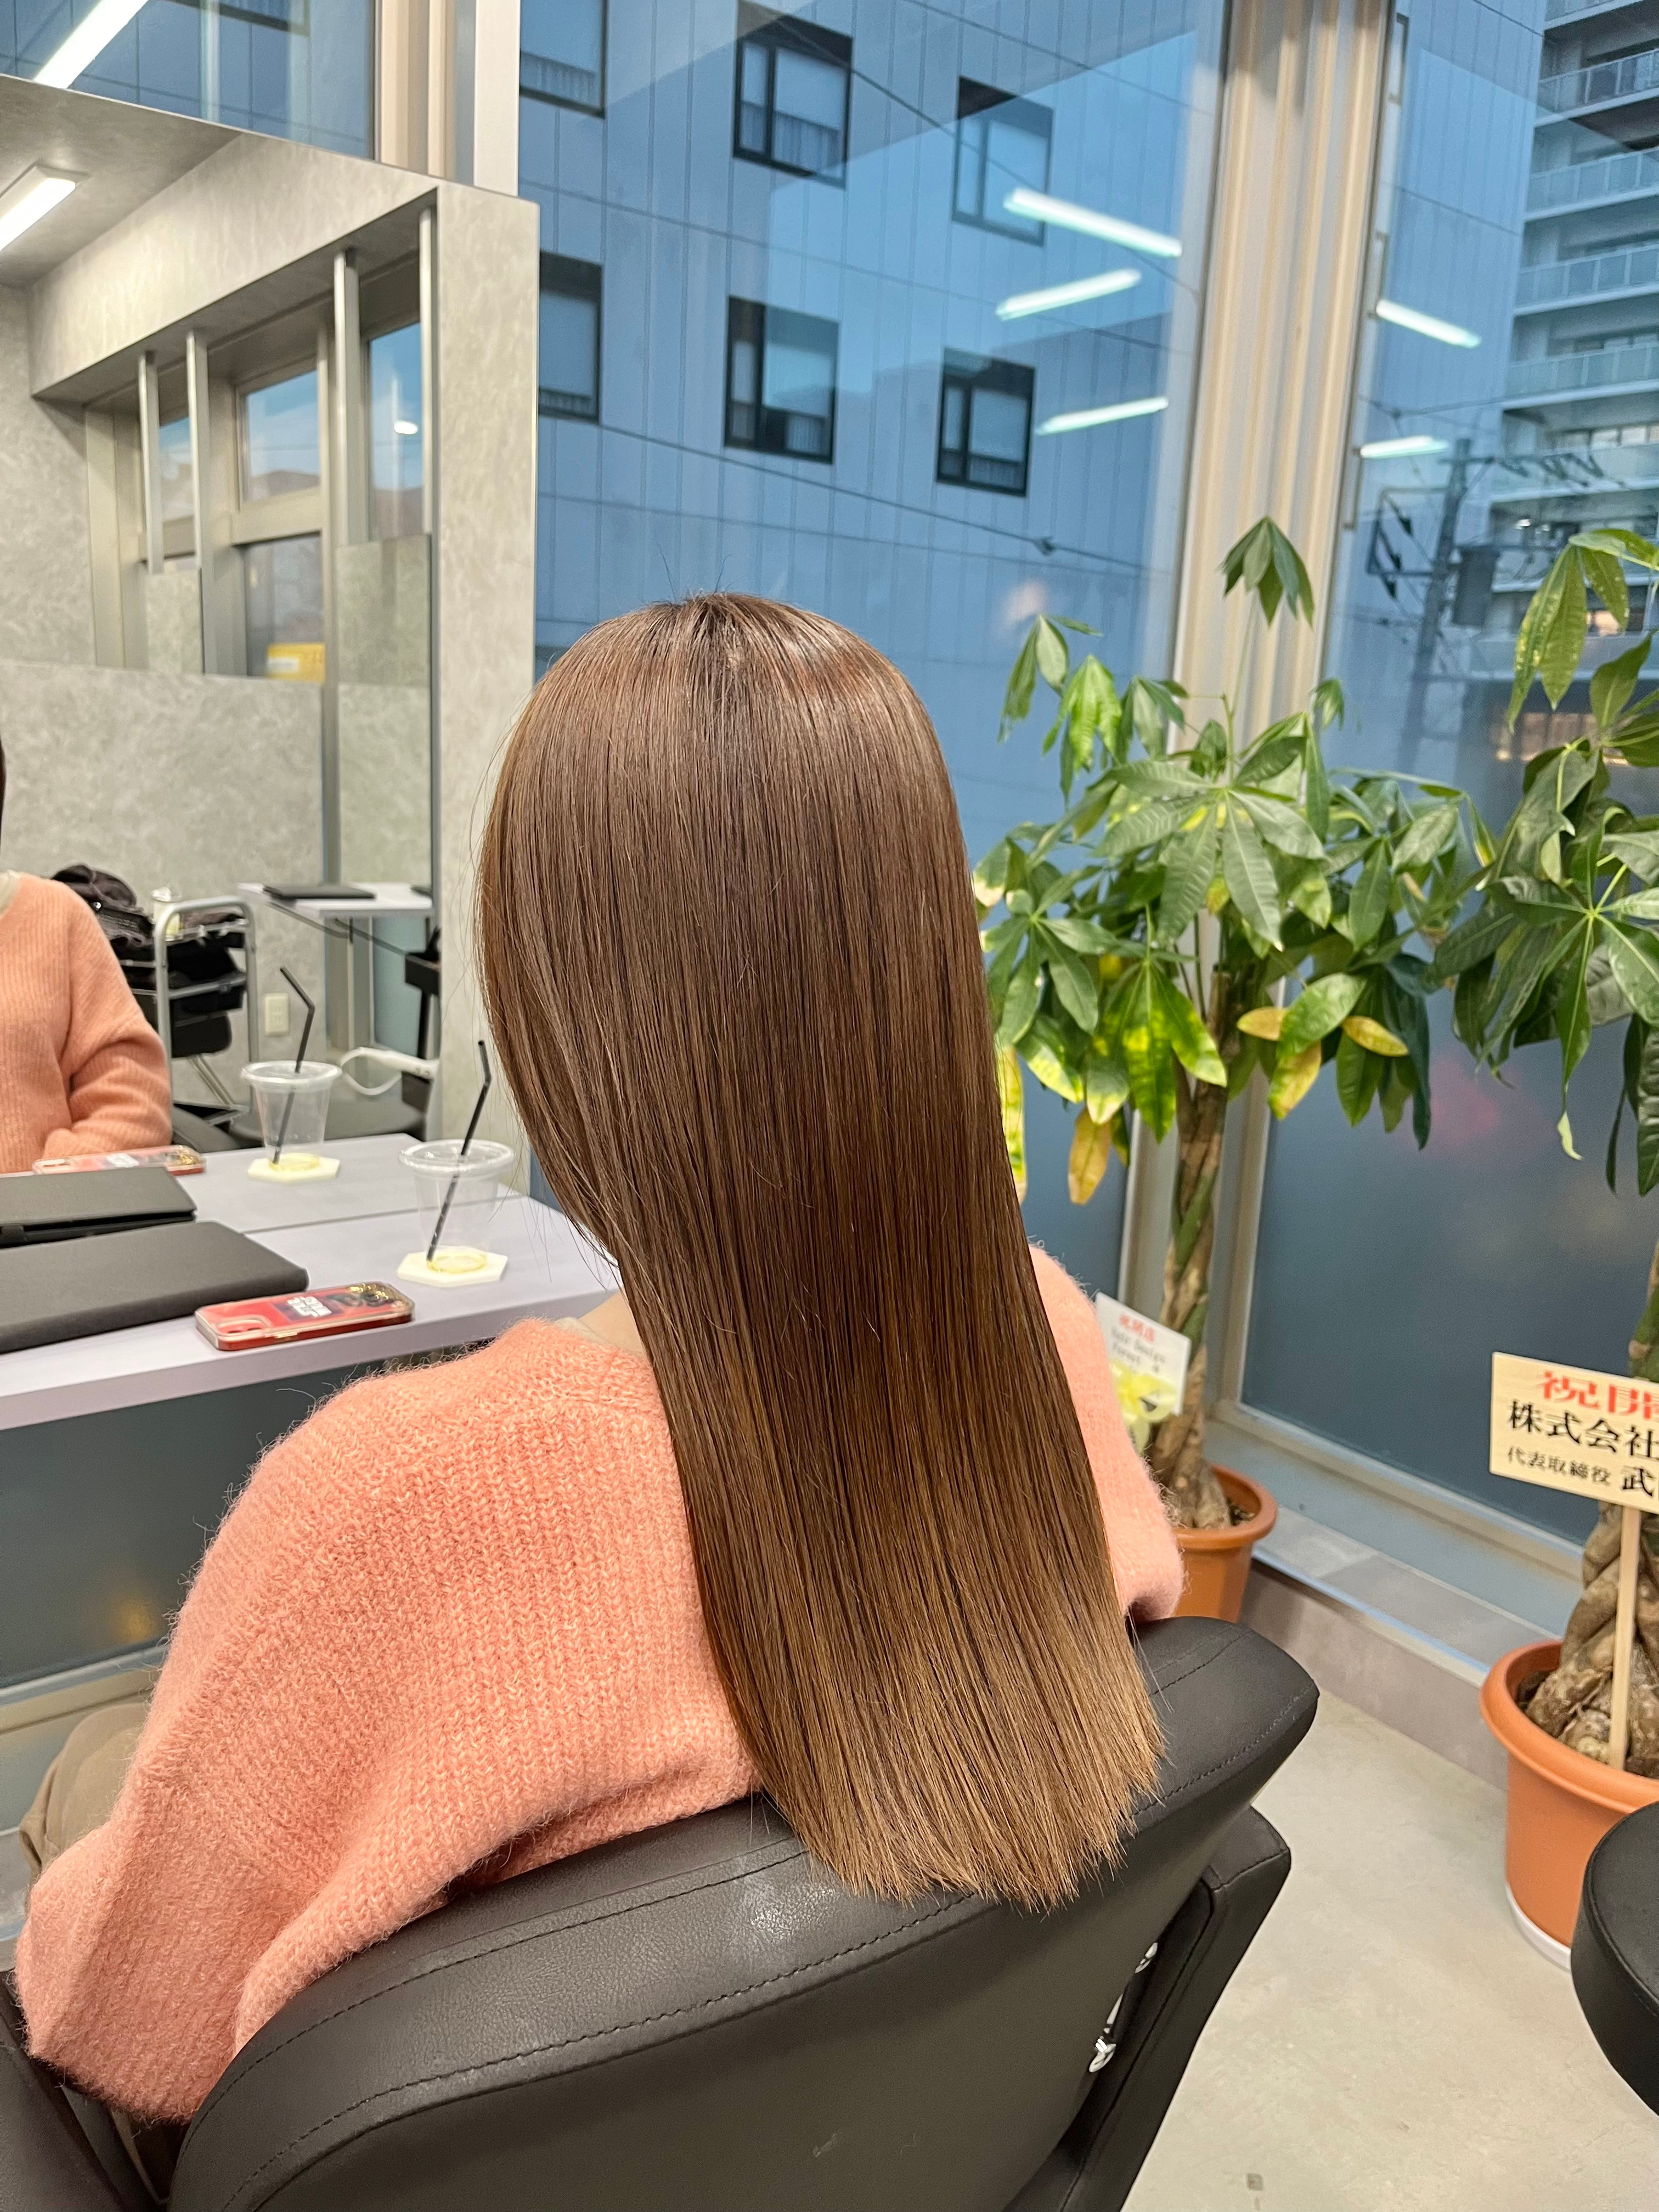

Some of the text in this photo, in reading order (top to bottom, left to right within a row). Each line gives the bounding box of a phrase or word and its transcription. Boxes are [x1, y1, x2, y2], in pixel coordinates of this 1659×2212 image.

[1508, 1400, 1659, 1461] 株式会社
[1508, 1445, 1659, 1498] 代表取締役 武
